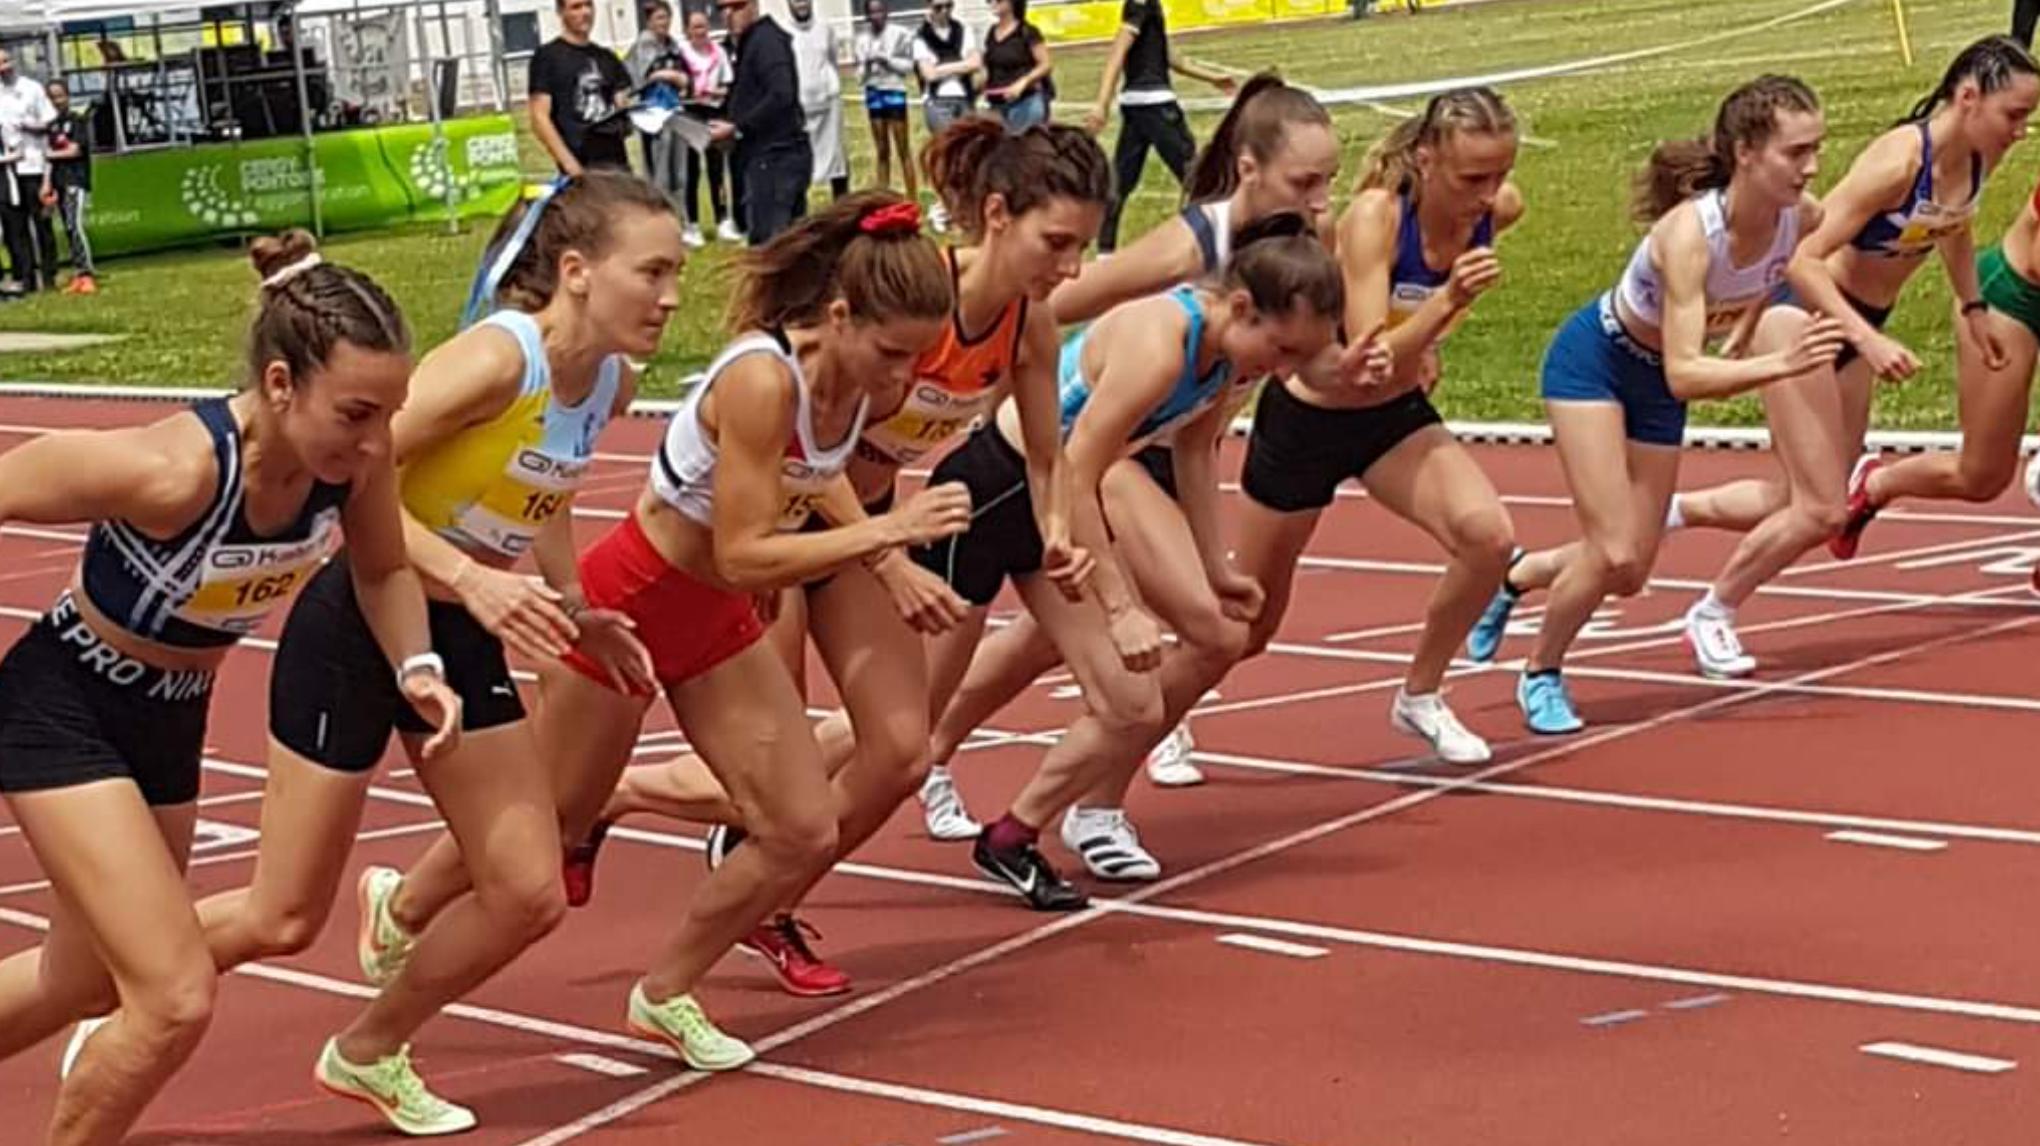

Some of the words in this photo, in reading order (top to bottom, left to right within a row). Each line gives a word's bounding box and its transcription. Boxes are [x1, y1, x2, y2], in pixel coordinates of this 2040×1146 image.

[235, 573, 296, 606] 162
[60, 622, 146, 686] PRO
[148, 671, 213, 701] NIK
